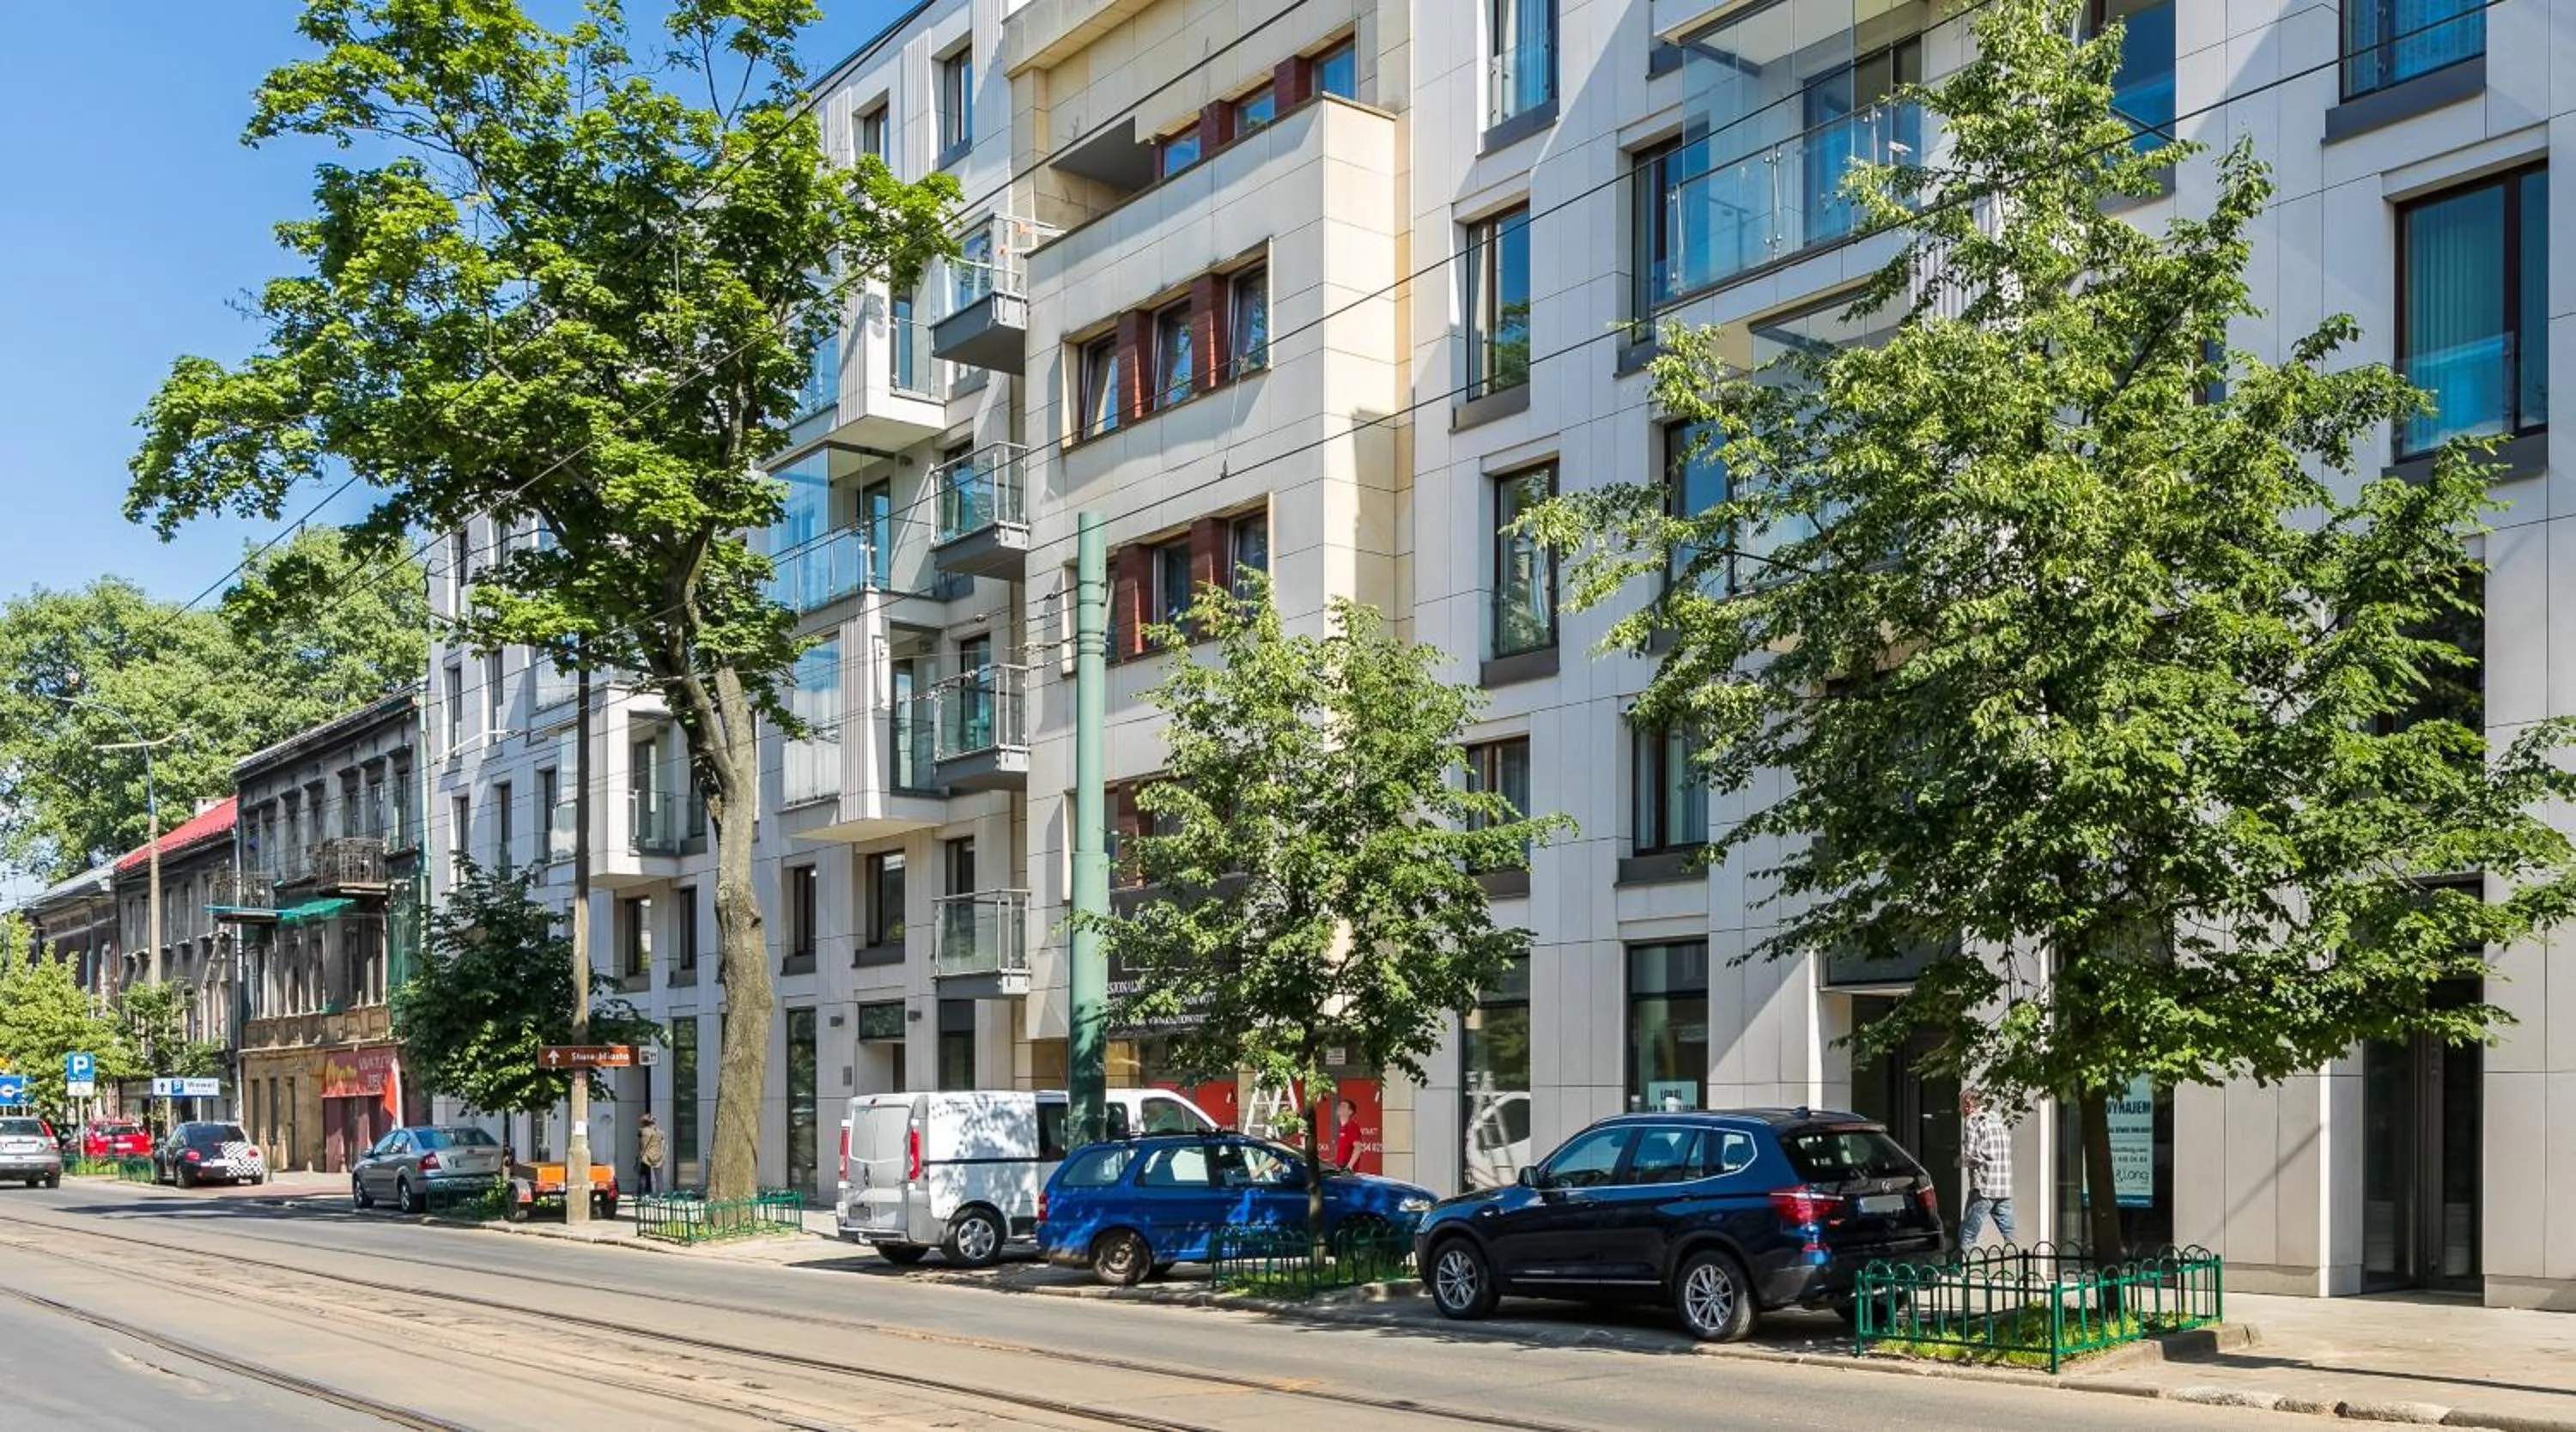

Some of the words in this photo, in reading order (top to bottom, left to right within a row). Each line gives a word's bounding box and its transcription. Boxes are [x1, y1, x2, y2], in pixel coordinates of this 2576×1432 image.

[571, 1051, 595, 1061] Stare
[598, 1050, 629, 1060] Miasto
[73, 1055, 88, 1074] P
